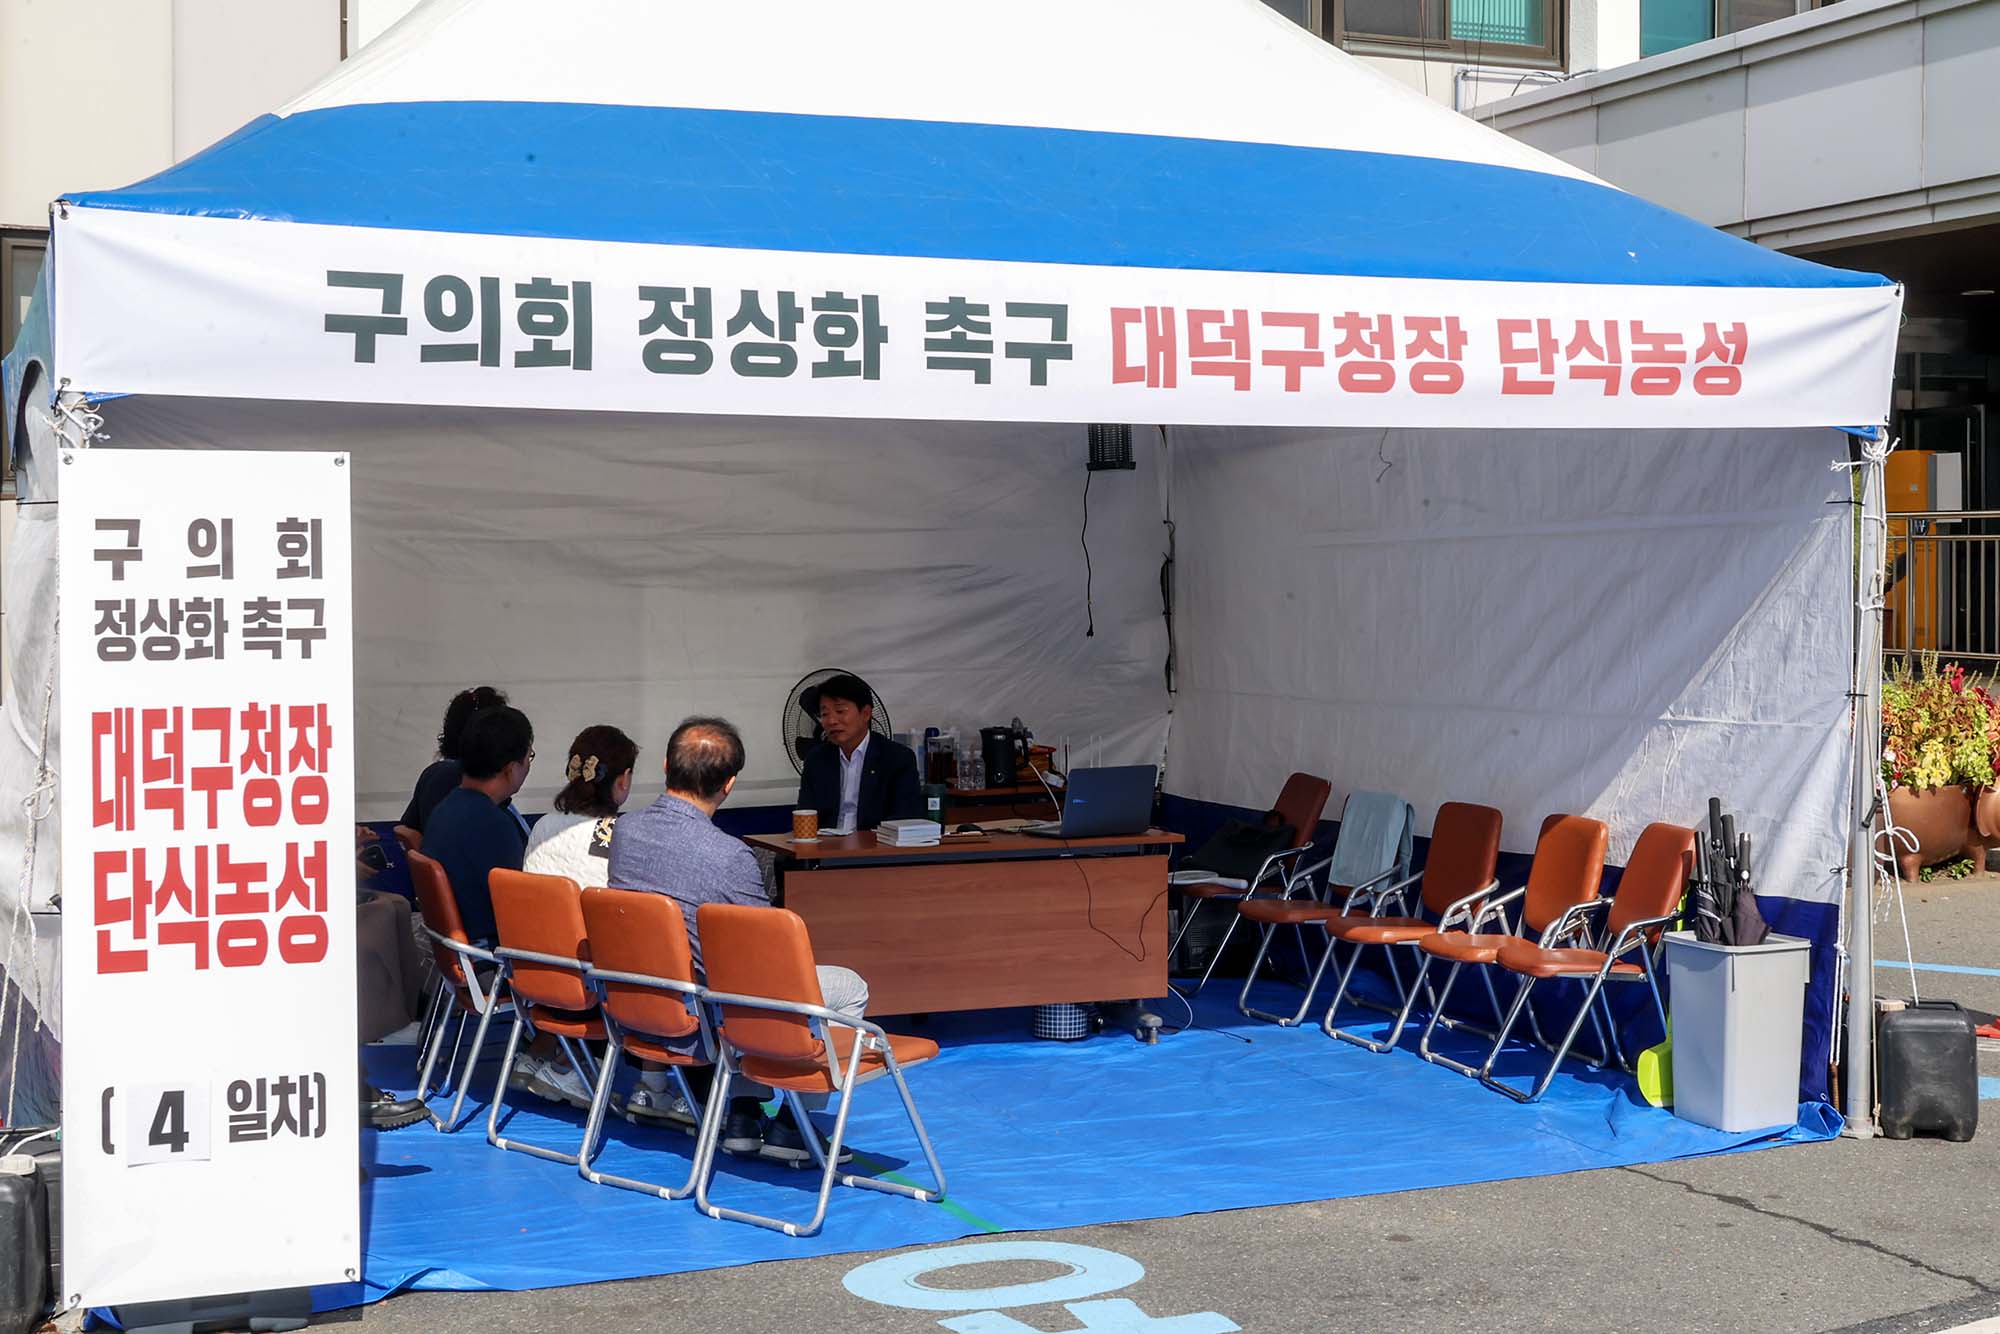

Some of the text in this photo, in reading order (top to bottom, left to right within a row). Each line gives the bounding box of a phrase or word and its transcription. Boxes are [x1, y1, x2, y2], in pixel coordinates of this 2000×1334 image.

[324, 270, 1748, 396] 구의회 정상화 촉구 대덕구청장 단식농성
[94, 596, 327, 662] 정상화 촉구
[91, 701, 333, 831] 대덕구청장
[93, 840, 329, 975] 단식농성
[226, 1071, 327, 1144] 일차)
